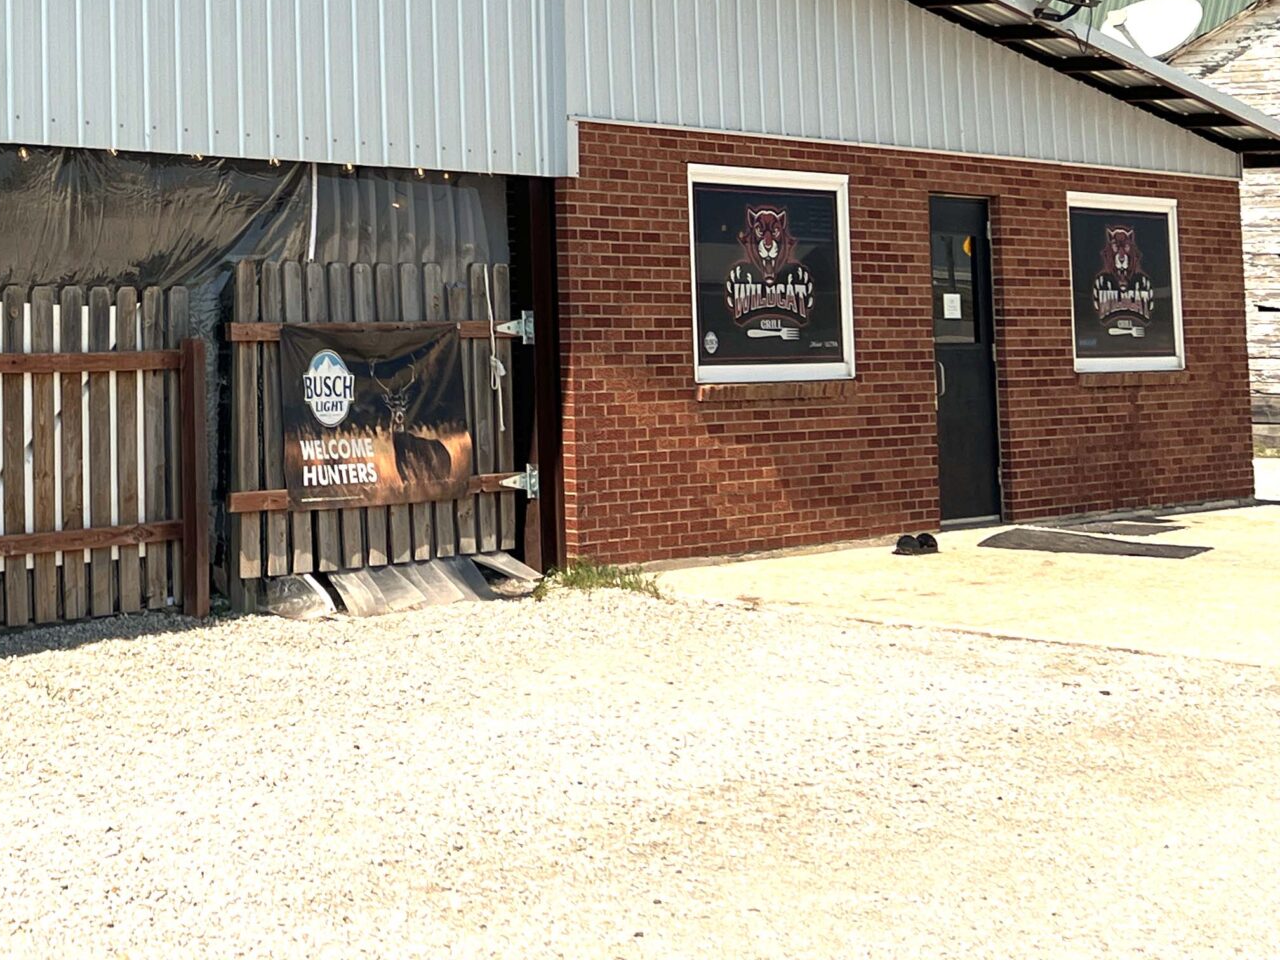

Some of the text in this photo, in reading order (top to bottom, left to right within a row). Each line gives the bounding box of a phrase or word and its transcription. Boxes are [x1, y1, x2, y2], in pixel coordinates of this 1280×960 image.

[734, 283, 807, 318] WILDCAT
[760, 320, 782, 330] GRILL
[304, 375, 353, 399] BUSCH
[315, 400, 343, 412] LIGHT
[300, 438, 374, 460] WELCOME
[303, 462, 377, 487] HUNTERS
